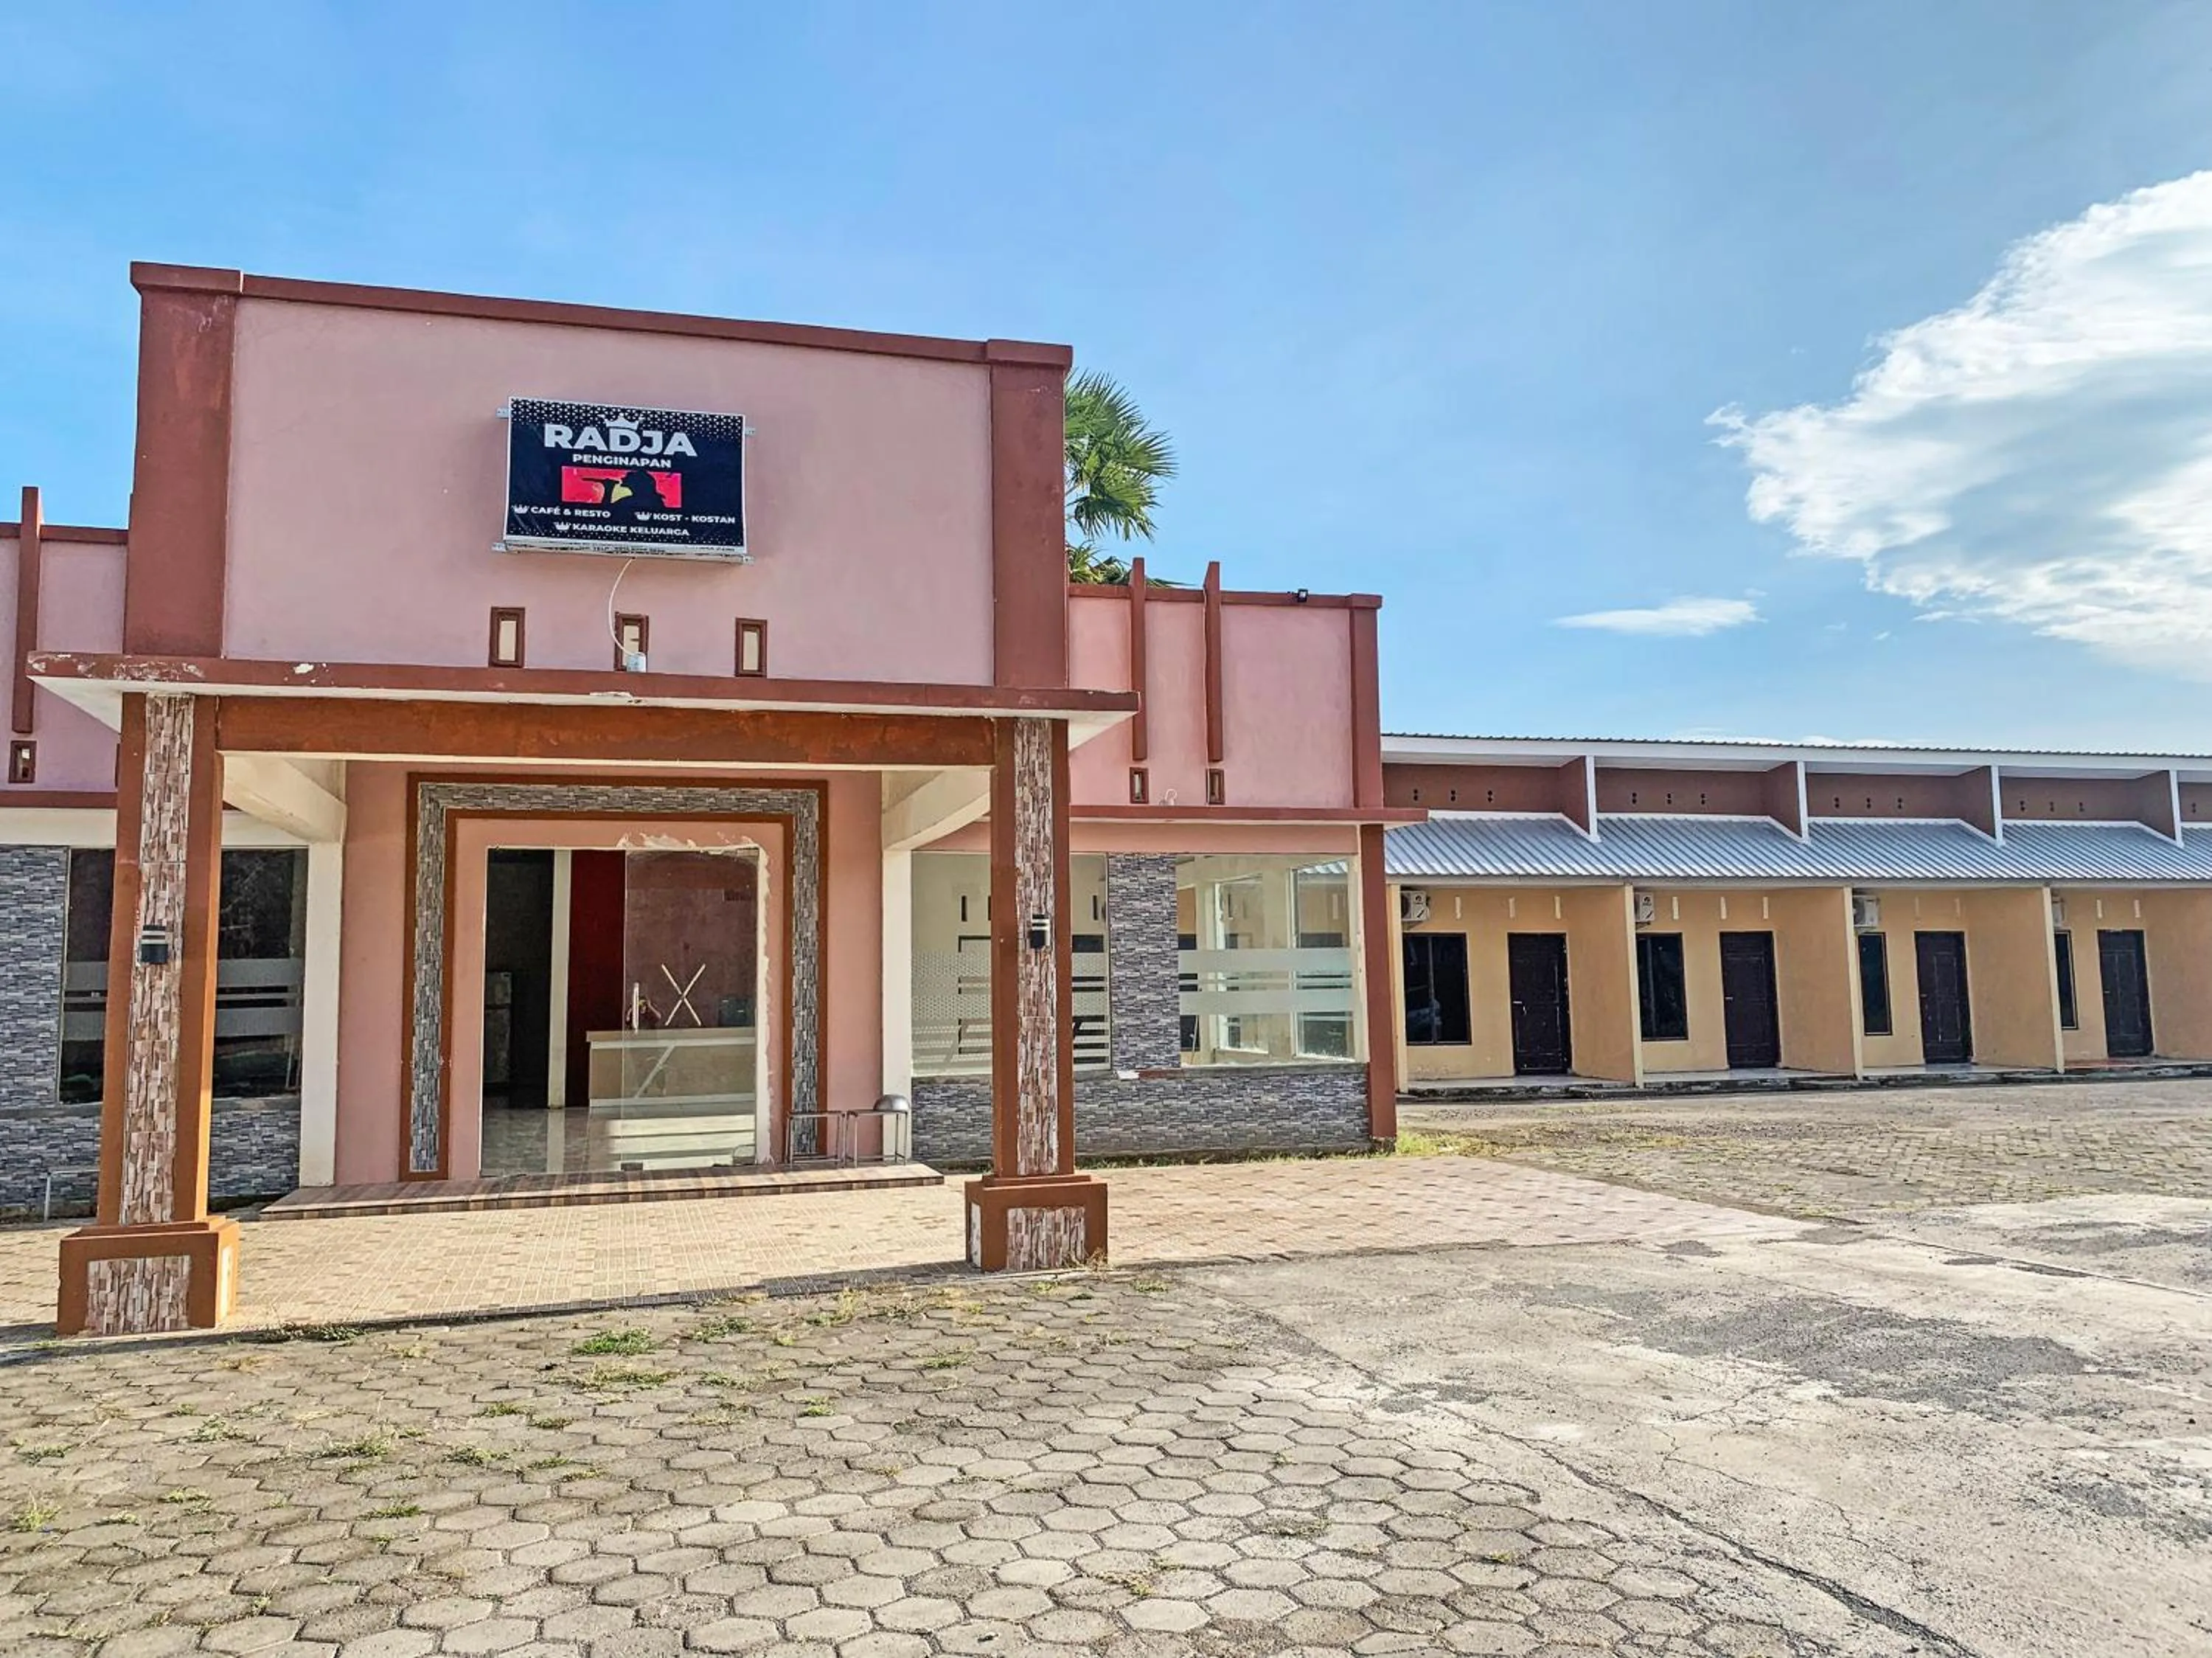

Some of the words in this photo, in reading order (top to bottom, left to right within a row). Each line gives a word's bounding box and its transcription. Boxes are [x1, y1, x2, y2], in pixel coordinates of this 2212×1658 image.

[544, 423, 698, 457] RADJA
[572, 454, 672, 468] PENGINAPAN
[530, 506, 560, 516] CAFÉ
[563, 508, 571, 516] &
[574, 510, 611, 518] RESTO
[653, 513, 683, 521] KOST
[691, 515, 736, 524] KOSTAN
[573, 524, 627, 533] KARAOKE
[630, 526, 689, 535] KELUARGA
